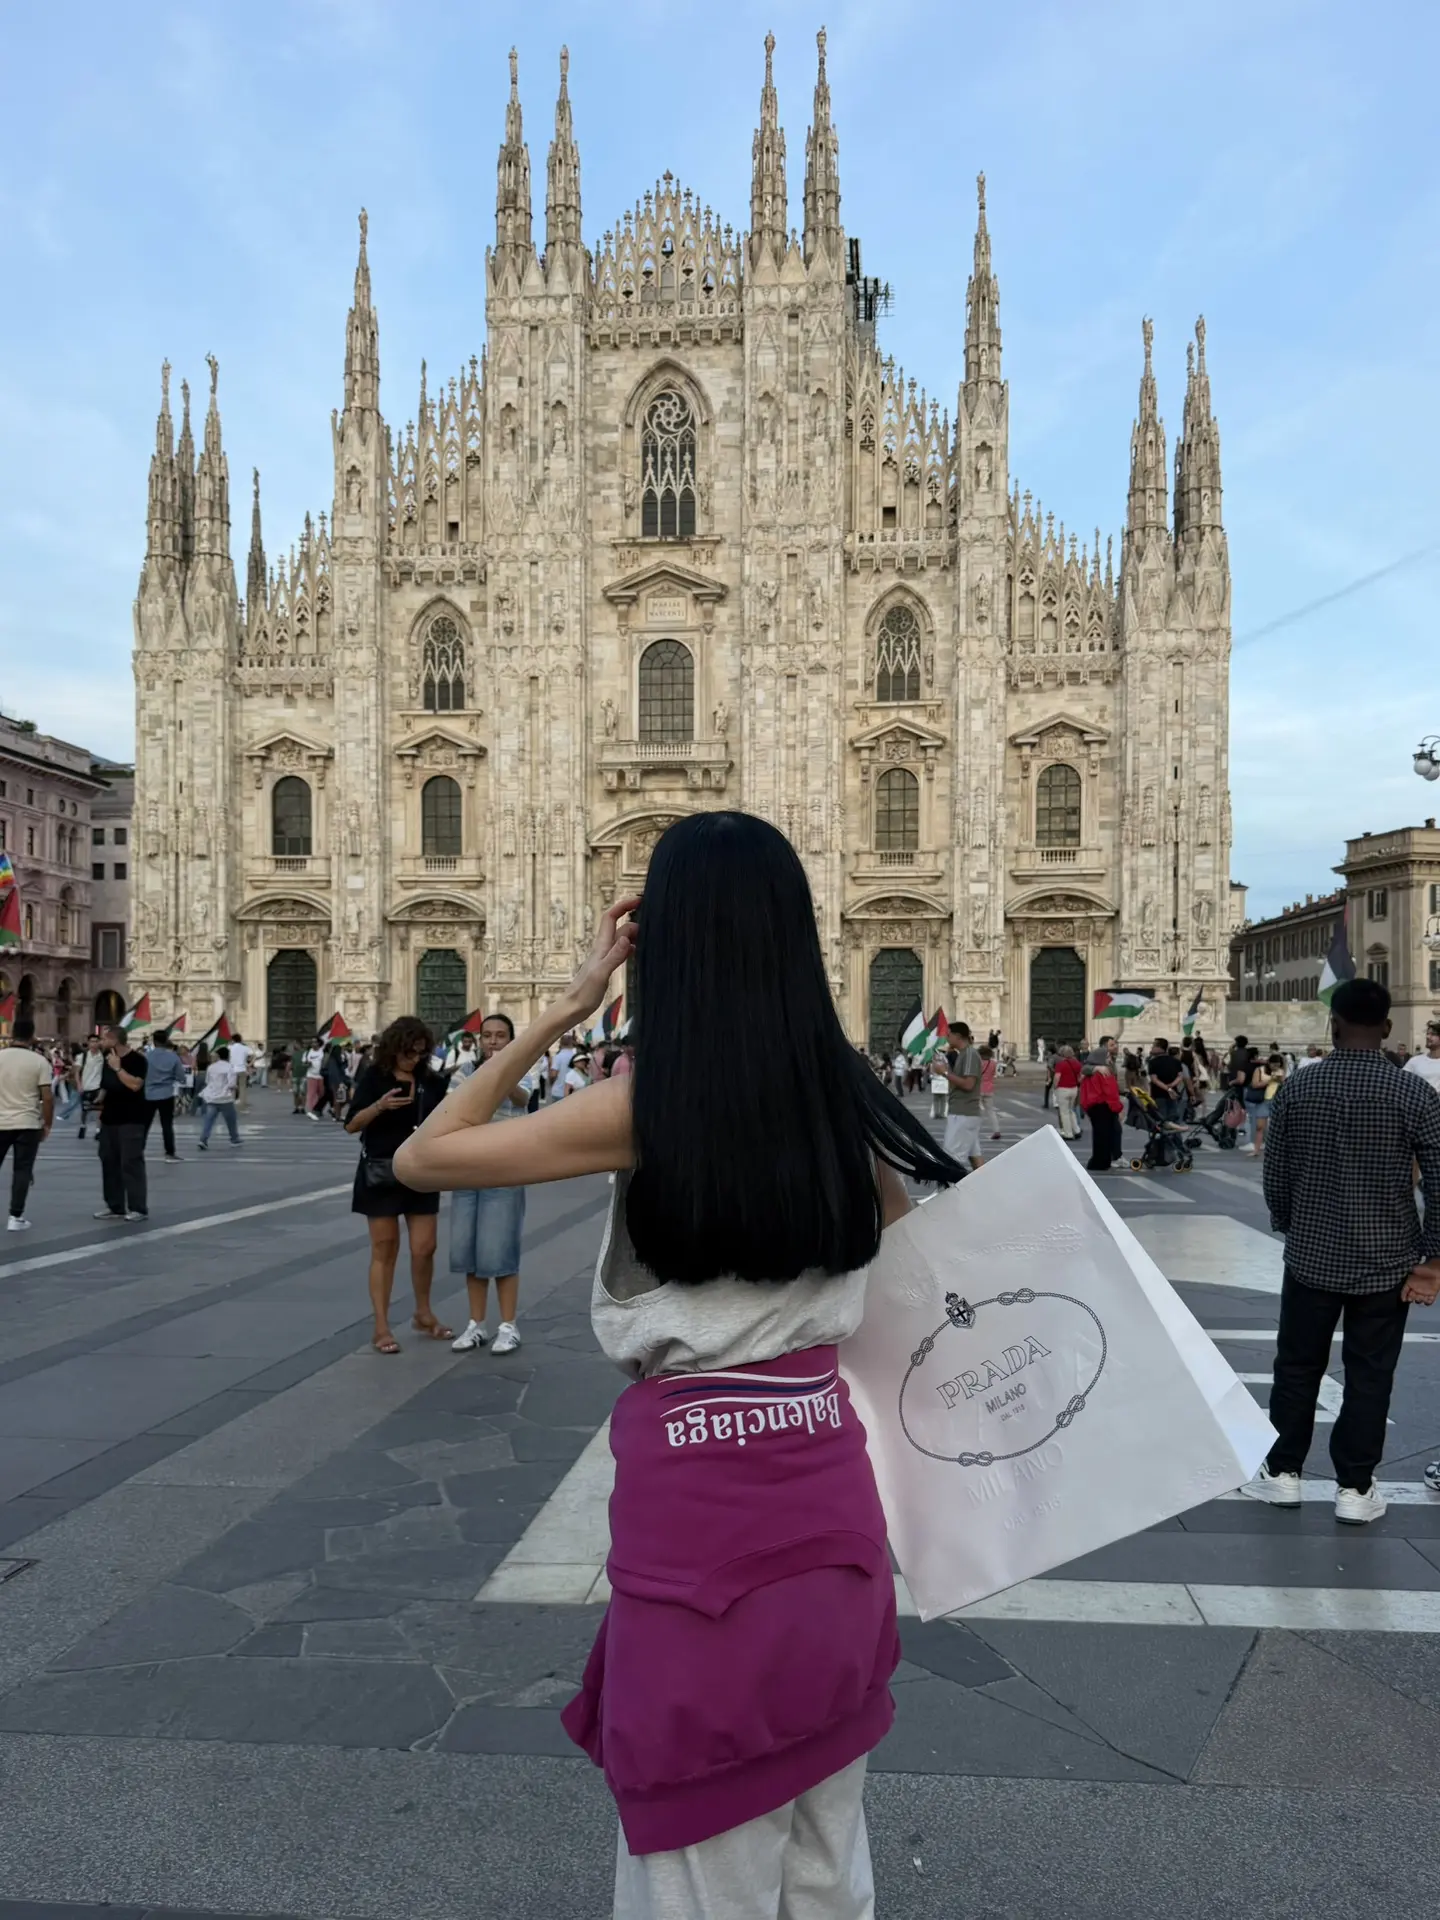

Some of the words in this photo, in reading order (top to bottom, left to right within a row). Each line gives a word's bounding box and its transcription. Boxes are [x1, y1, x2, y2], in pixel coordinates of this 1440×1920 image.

[936, 1335, 1052, 1410] PRADA
[985, 1382, 1026, 1415] MILANO
[665, 1393, 842, 1447] Balenciaga
